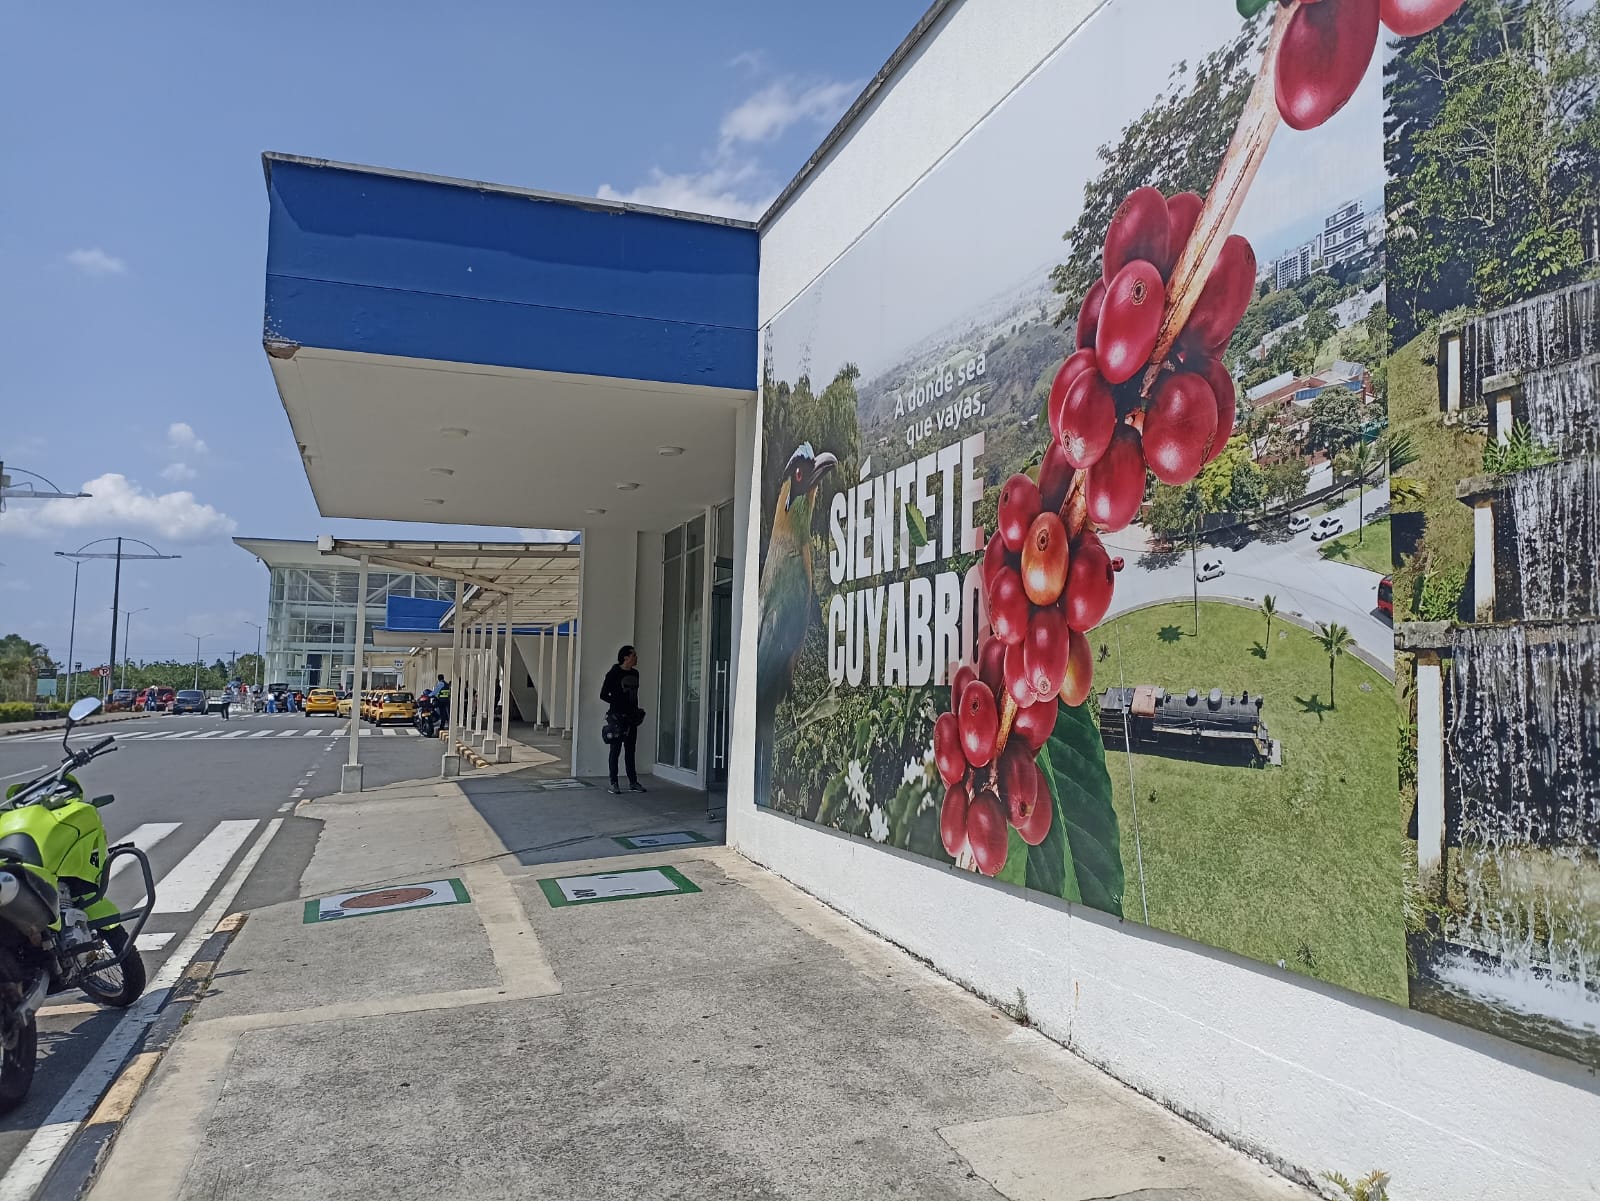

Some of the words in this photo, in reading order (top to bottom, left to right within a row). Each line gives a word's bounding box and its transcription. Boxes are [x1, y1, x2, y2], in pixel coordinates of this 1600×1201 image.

[894, 394, 905, 419] A
[907, 363, 954, 412] donde
[957, 352, 986, 386] sea
[906, 416, 933, 450] que
[936, 391, 986, 431] vayas,
[829, 431, 986, 585] SIÉNTETE
